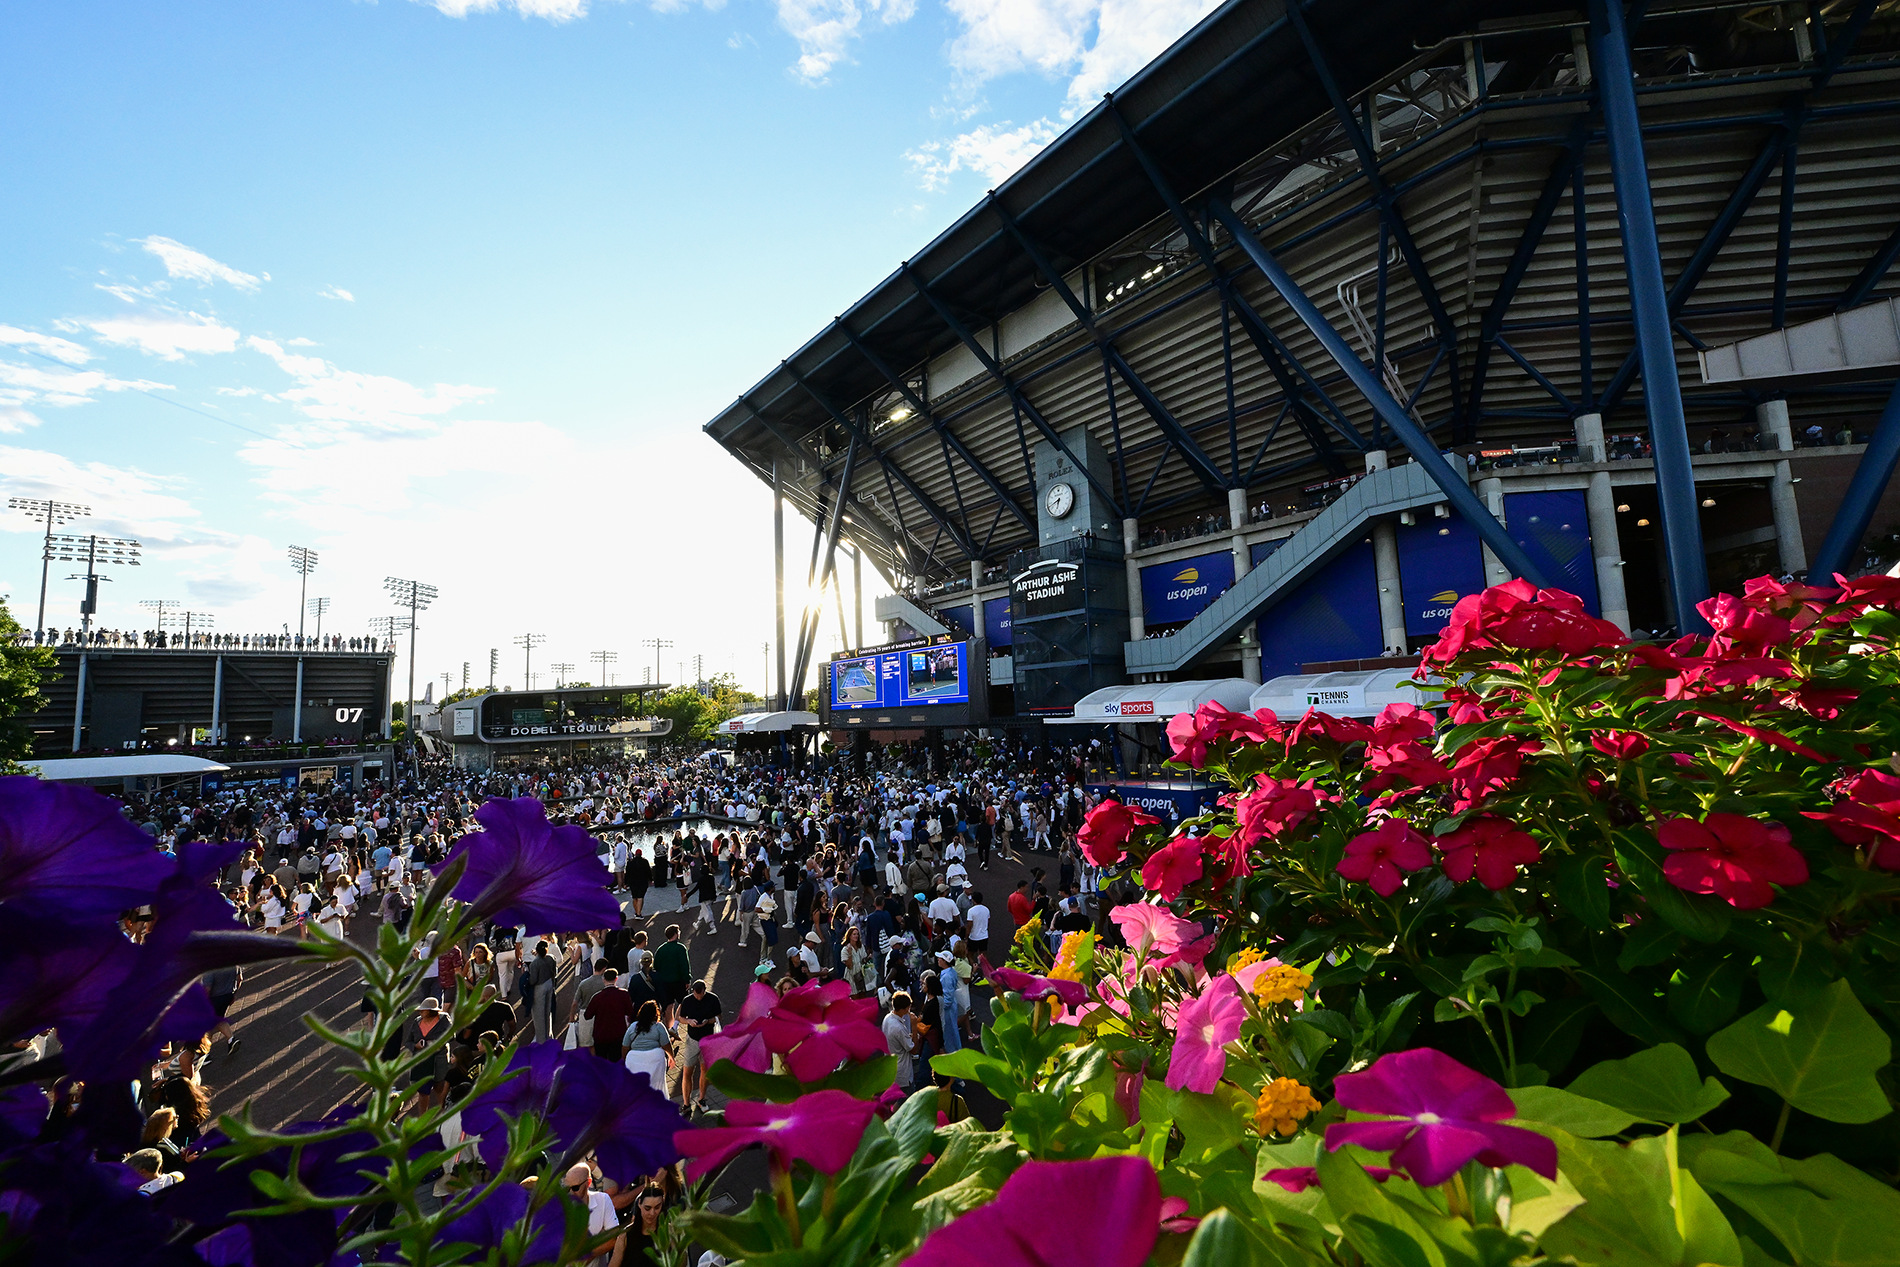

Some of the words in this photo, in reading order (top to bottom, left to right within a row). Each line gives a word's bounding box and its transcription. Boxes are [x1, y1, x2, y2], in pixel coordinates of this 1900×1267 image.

[1049, 466, 1073, 480] ROLEX
[1016, 576, 1050, 592] ARTHUR
[1052, 570, 1077, 584] ASHE
[1027, 585, 1065, 601] STADIUM
[1167, 590, 1180, 600] us
[1180, 585, 1208, 600] open
[1422, 610, 1437, 619] us
[1437, 607, 1453, 619] op
[1320, 691, 1349, 699] TENNIS
[1104, 703, 1119, 714] sky
[1122, 703, 1152, 714] sports
[335, 708, 363, 723] 07
[510, 726, 557, 736] DOBEL
[562, 723, 611, 734] TEQUILA
[1141, 798, 1172, 811] open
